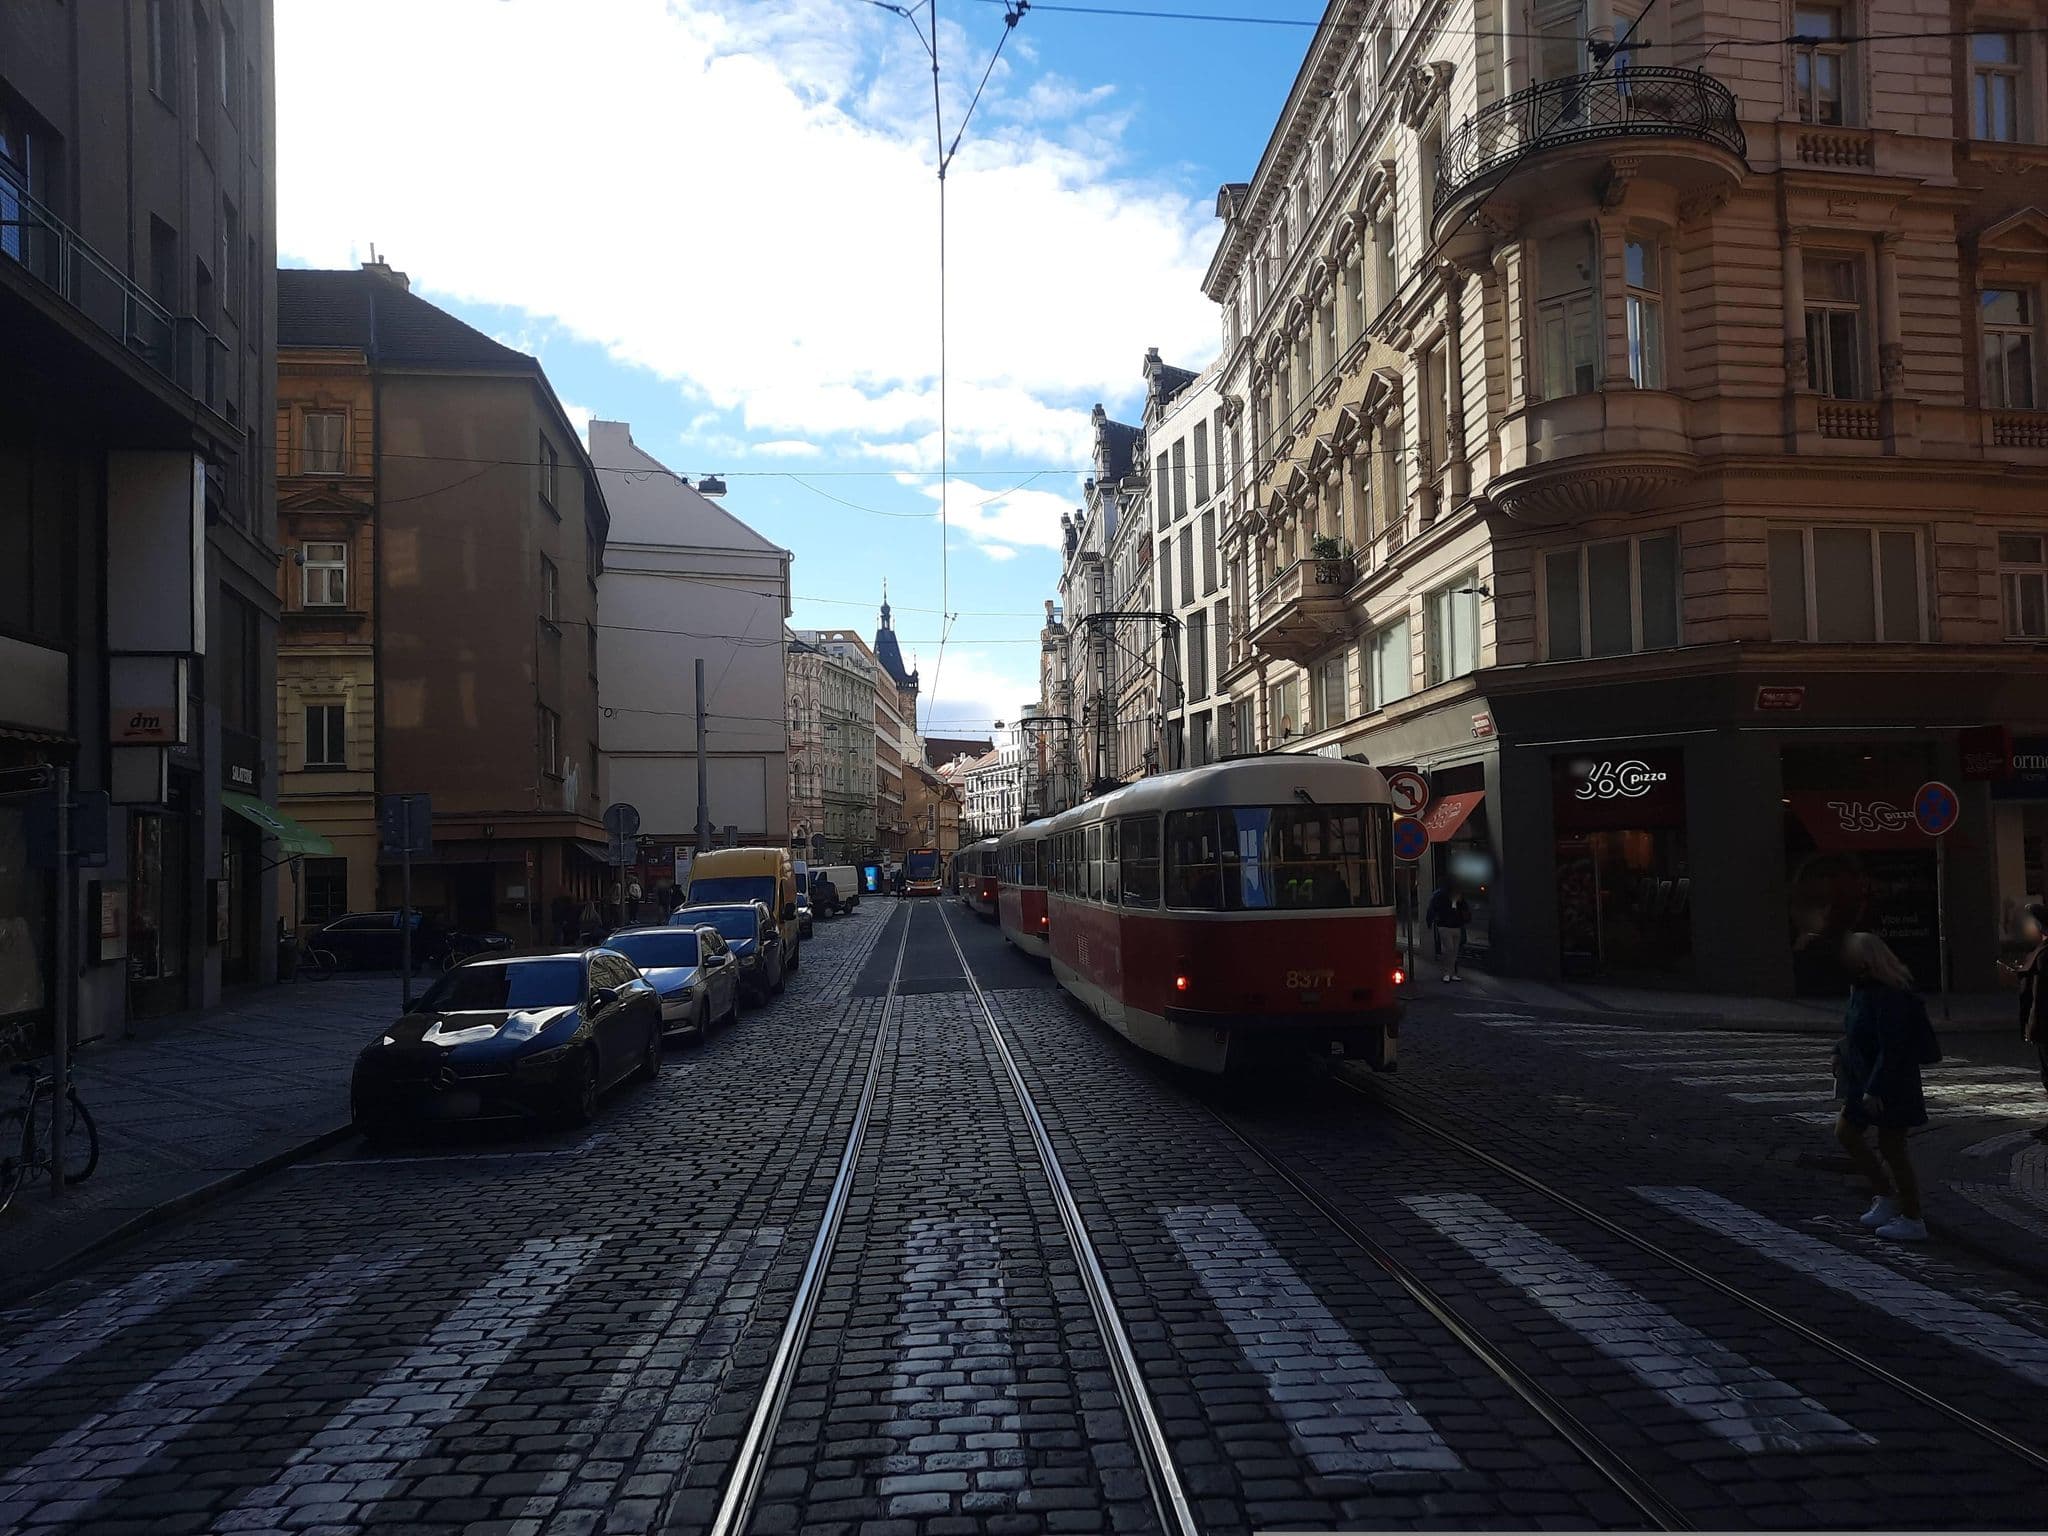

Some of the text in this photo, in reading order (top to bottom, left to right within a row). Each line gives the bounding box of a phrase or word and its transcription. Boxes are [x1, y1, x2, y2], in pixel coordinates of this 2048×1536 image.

[130, 712, 160, 727] dm
[2013, 755, 2048, 769] orm
[1630, 772, 1667, 784] pizza
